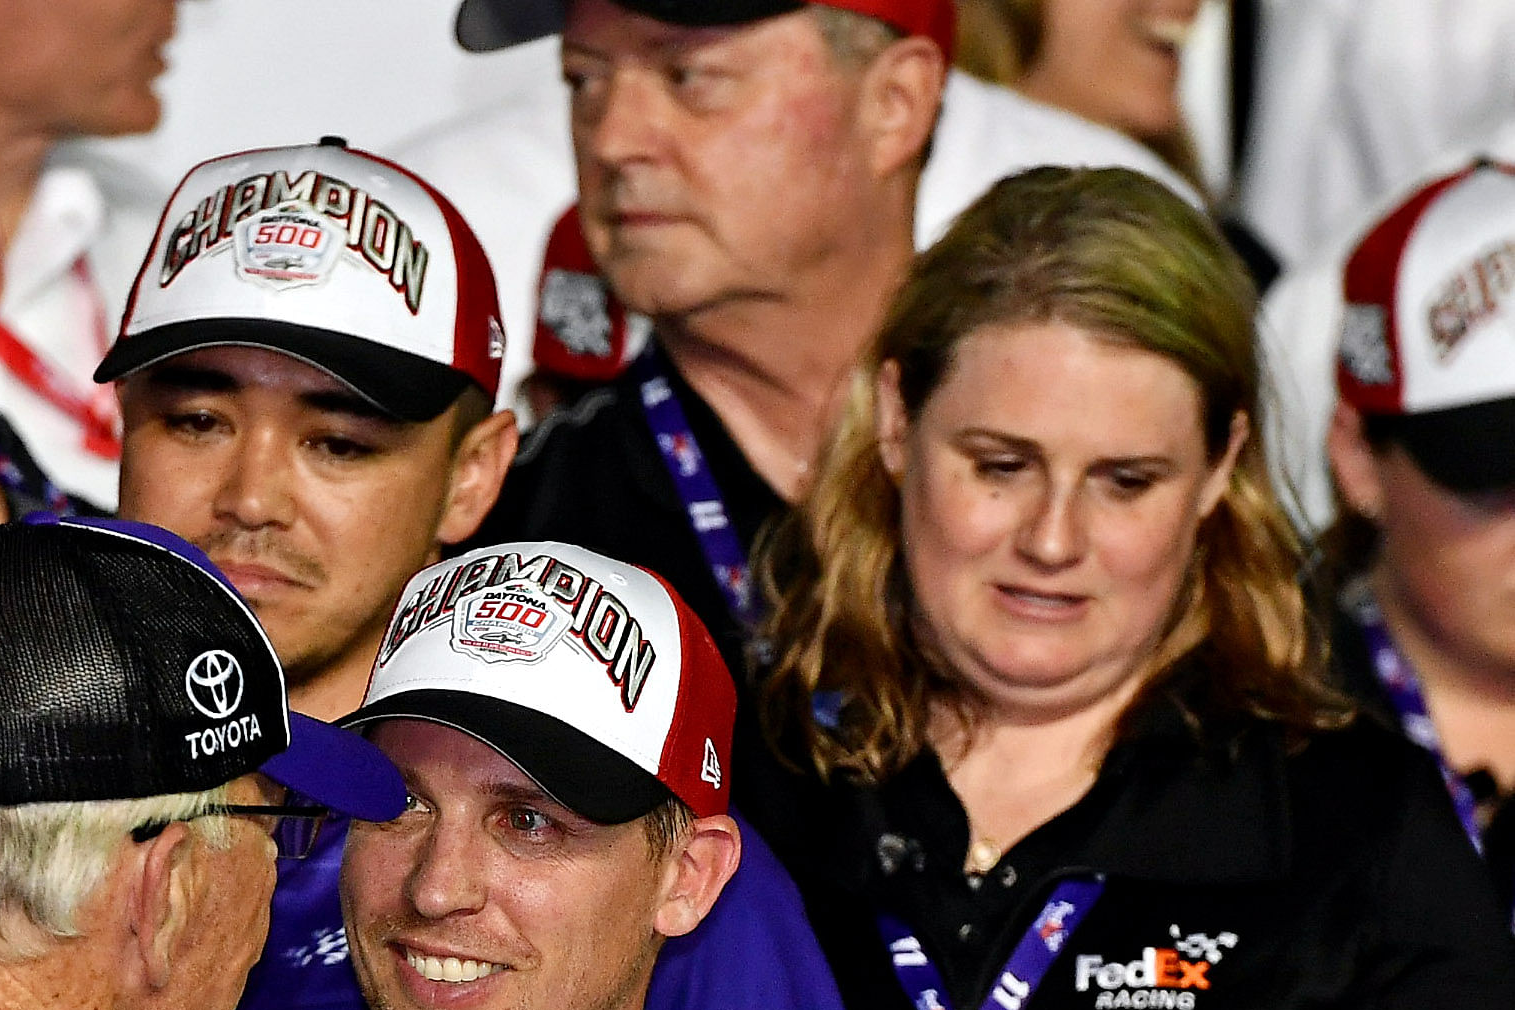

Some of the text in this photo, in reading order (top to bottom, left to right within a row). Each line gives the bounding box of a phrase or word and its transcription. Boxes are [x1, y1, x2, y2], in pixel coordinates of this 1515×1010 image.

[160, 170, 429, 316] CHAMPION
[255, 225, 322, 249] 500
[474, 601, 547, 628] 500
[484, 592, 546, 611] DAYTONA
[379, 553, 657, 713] CHAMPION
[185, 713, 262, 759] TOYOTA
[1076, 947, 1212, 992] FedEx
[1095, 989, 1196, 1010] RACING
